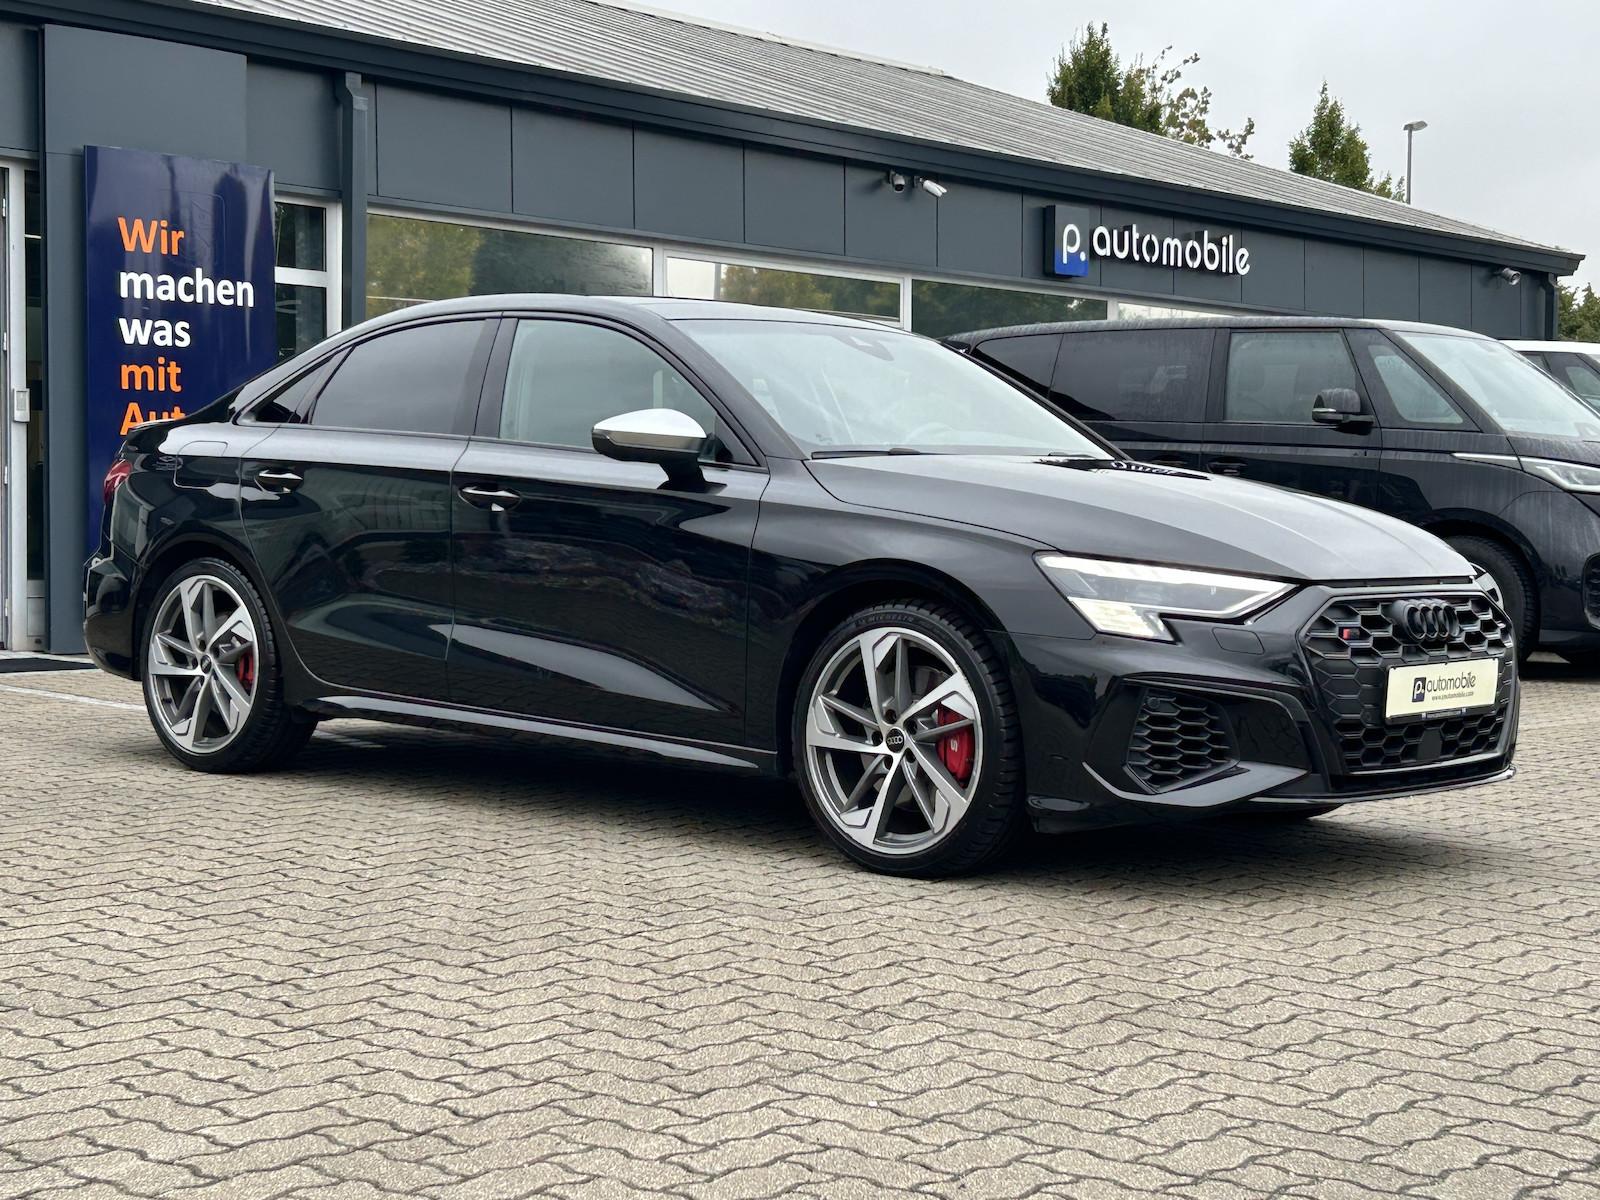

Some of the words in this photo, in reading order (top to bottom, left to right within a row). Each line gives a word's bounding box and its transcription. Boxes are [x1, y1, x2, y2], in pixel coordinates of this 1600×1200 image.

[118, 216, 184, 255] Wir
[1092, 224, 1250, 276] automobile
[120, 267, 254, 307] machen
[119, 318, 191, 347] was
[121, 356, 182, 392] mit
[1427, 671, 1476, 693] automobile
